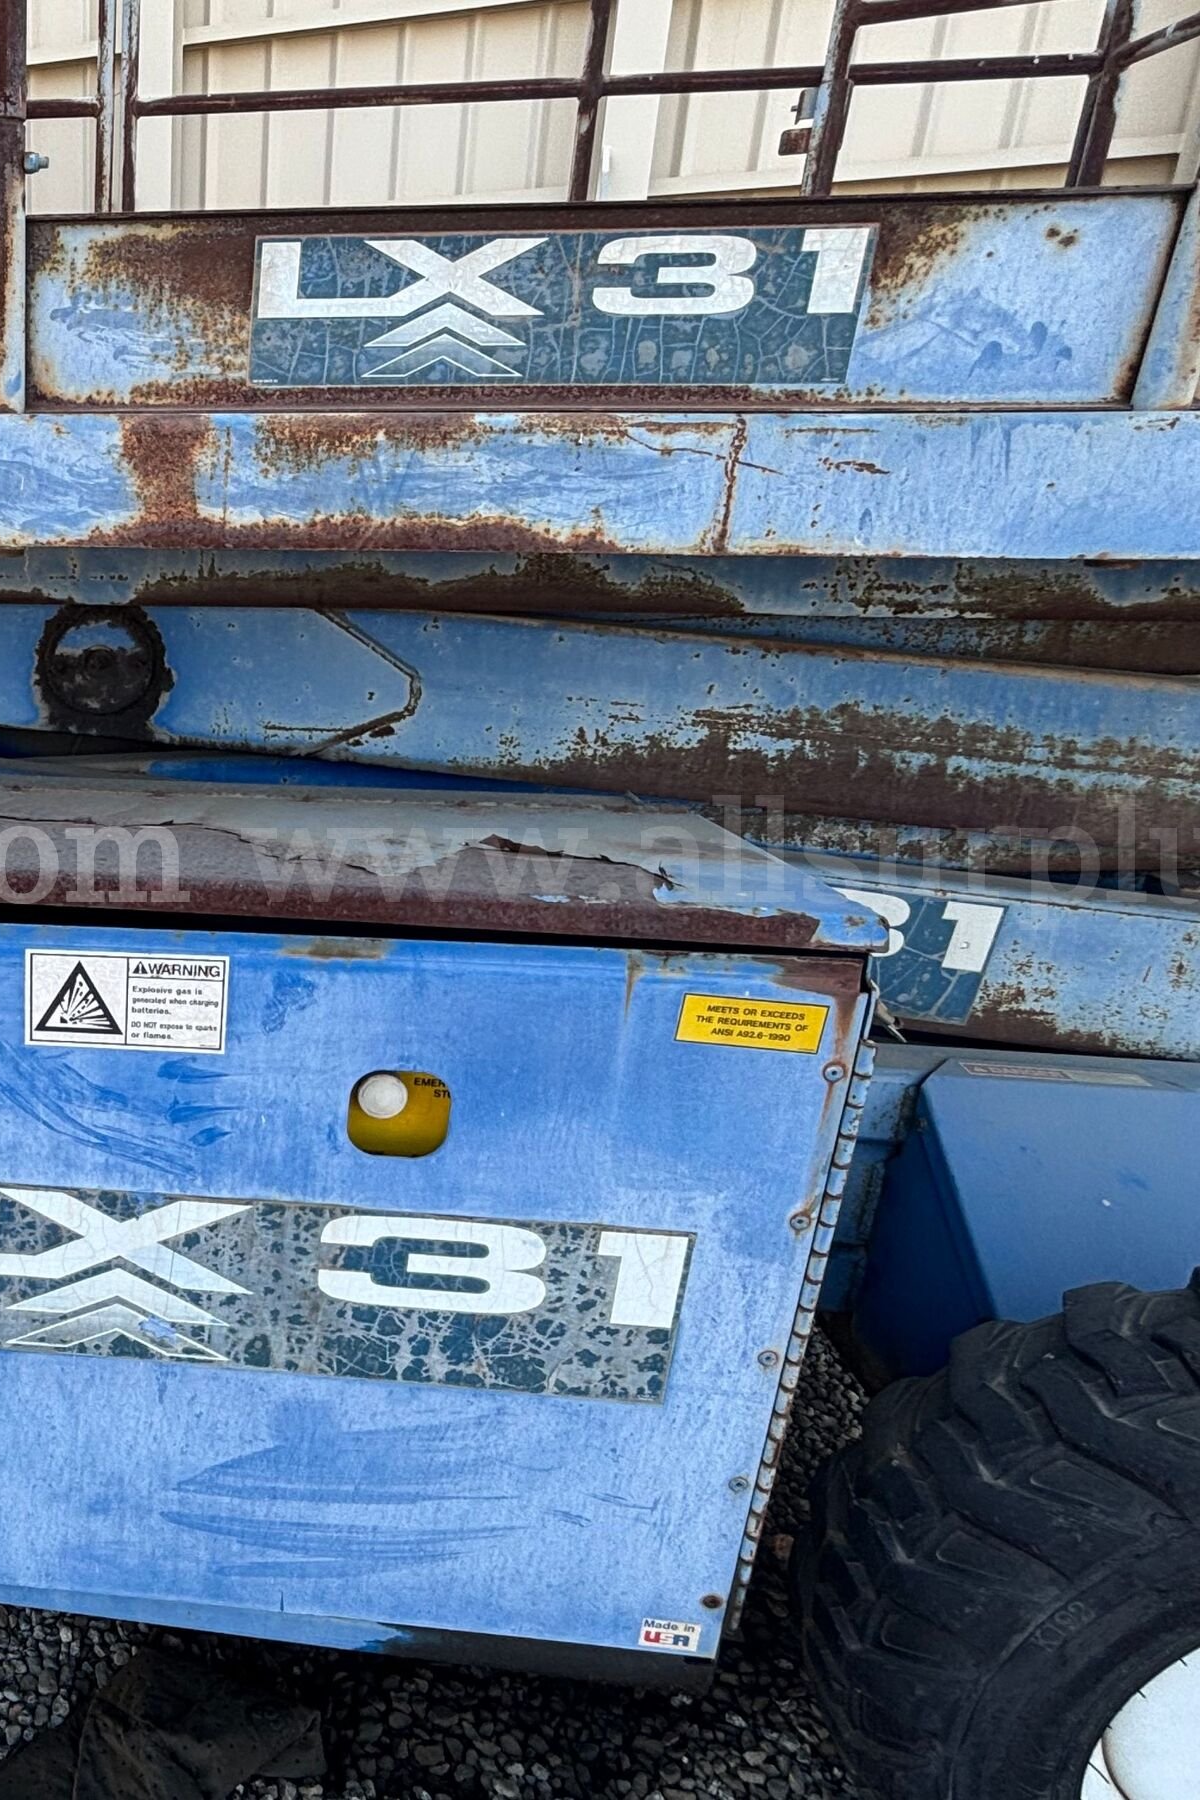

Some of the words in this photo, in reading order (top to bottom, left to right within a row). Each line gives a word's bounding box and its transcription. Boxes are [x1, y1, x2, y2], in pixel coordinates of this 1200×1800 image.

[257, 237, 549, 319] LX
[592, 227, 870, 315] 31
[148, 963, 220, 977] WARNING
[132, 985, 173, 995] Explosive
[132, 997, 166, 1005] generated
[169, 997, 187, 1005] when
[189, 999, 219, 1008] charging
[131, 1006, 171, 1015] batteries.
[707, 1004, 739, 1015] MEETS
[743, 1007, 757, 1016] OR
[760, 1009, 806, 1021] EXCEEDS
[143, 1021, 157, 1029] NOT
[696, 1015, 714, 1024] THE
[717, 1017, 791, 1031] REQUIREMENTS
[795, 1024, 809, 1032] OF
[710, 1028, 734, 1037] ANSI
[736, 1031, 791, 1042] A92.6-1990
[319, 1215, 689, 1329] 31
[643, 1619, 679, 1631] Made
[684, 1624, 695, 1633] in
[644, 1630, 690, 1647] USA
